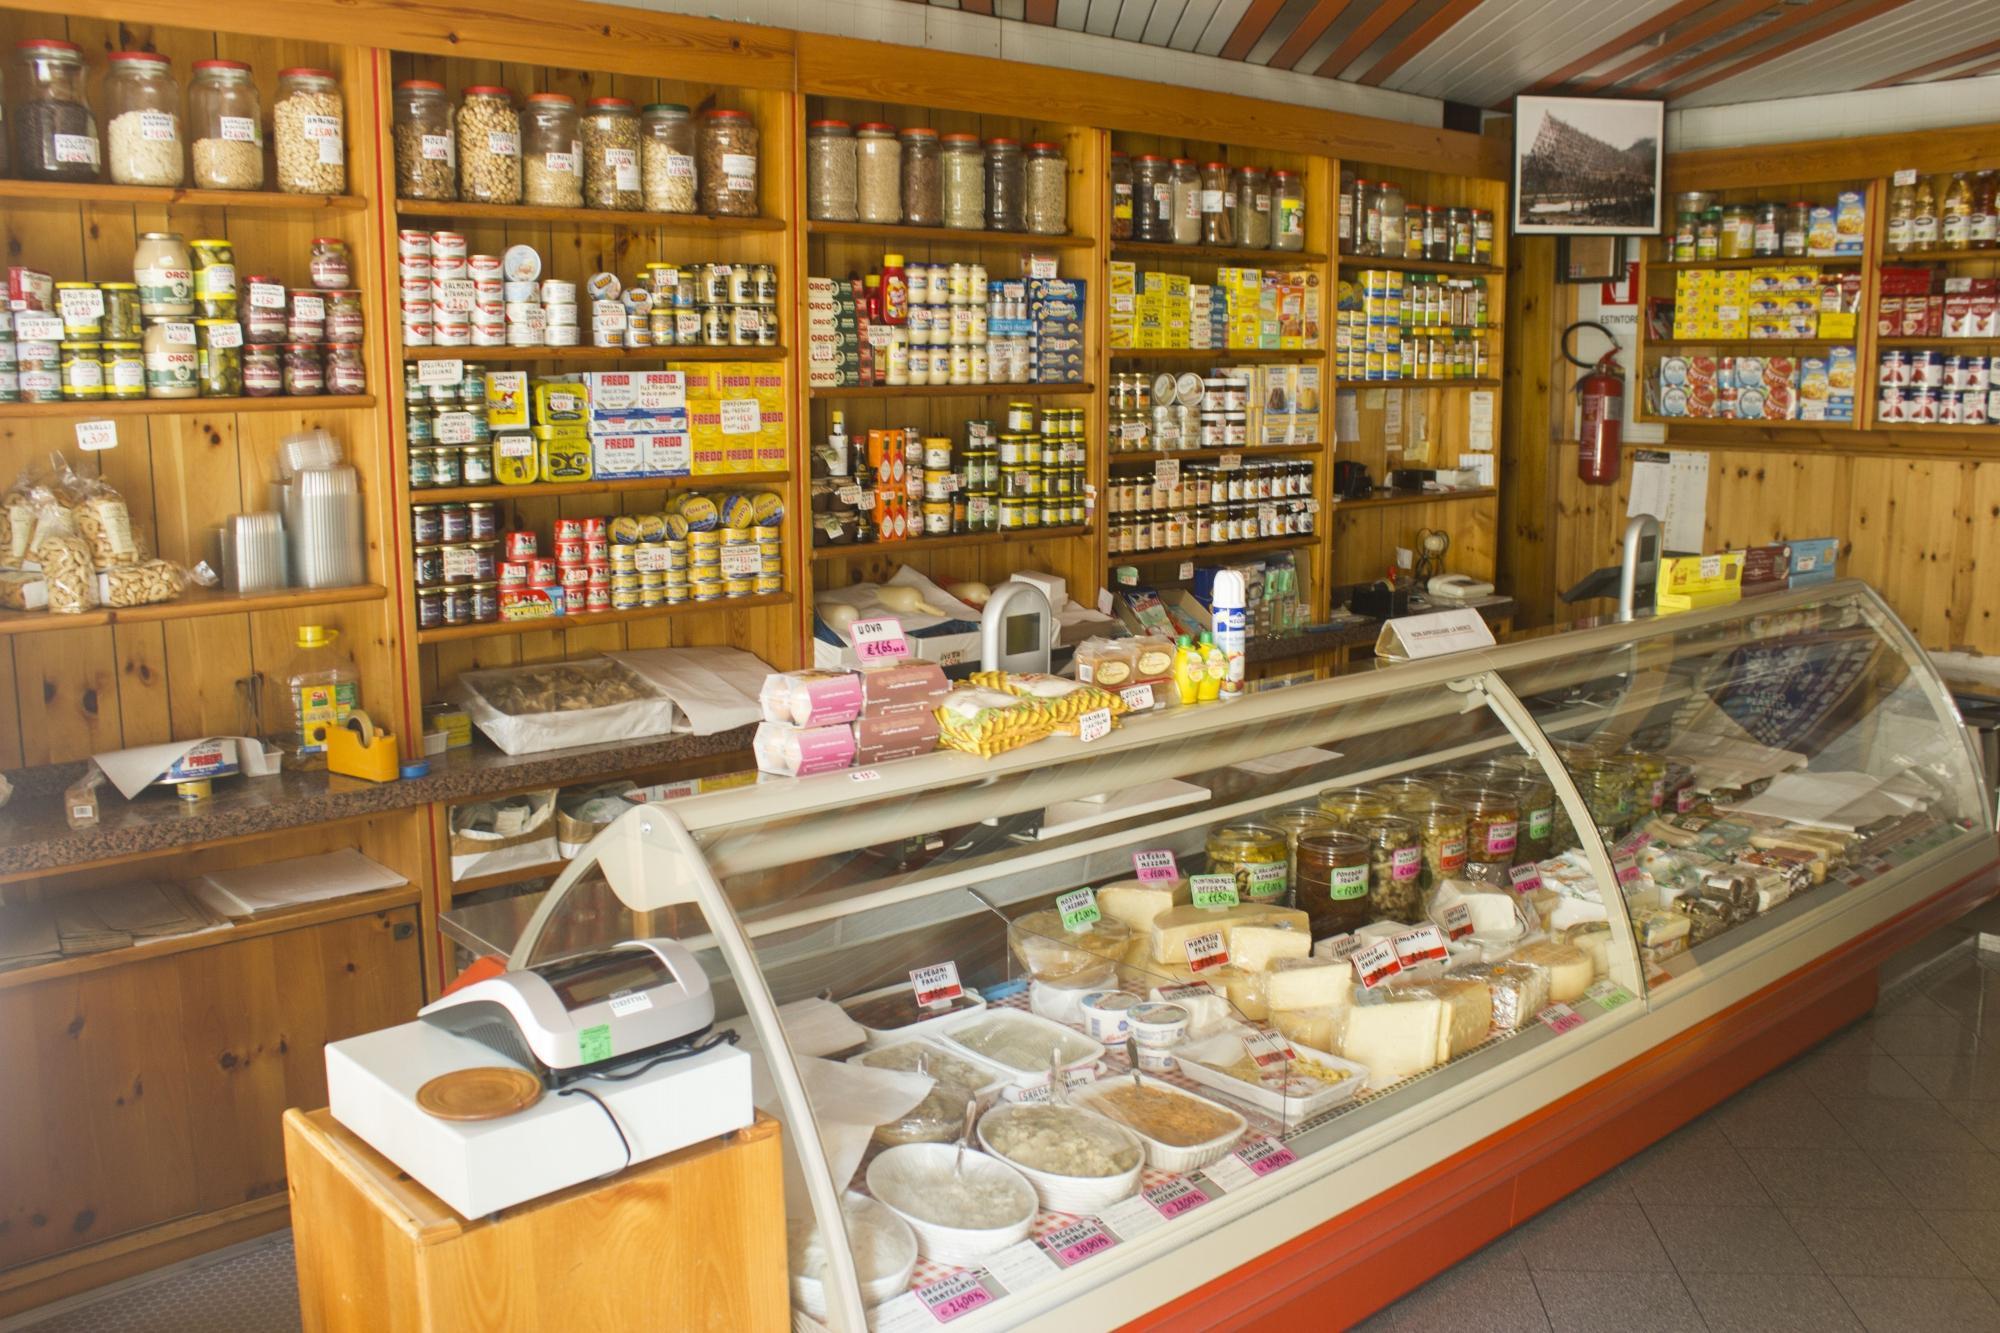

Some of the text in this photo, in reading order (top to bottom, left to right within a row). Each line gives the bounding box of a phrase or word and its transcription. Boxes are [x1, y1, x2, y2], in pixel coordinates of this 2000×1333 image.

[165, 271, 190, 279] ORCO
[810, 283, 831, 291] ORCO
[810, 302, 832, 310] ORCO
[812, 334, 835, 342] ORCO
[168, 355, 194, 363] ORCO
[811, 372, 835, 382] ORCO
[857, 623, 883, 635] UOVA
